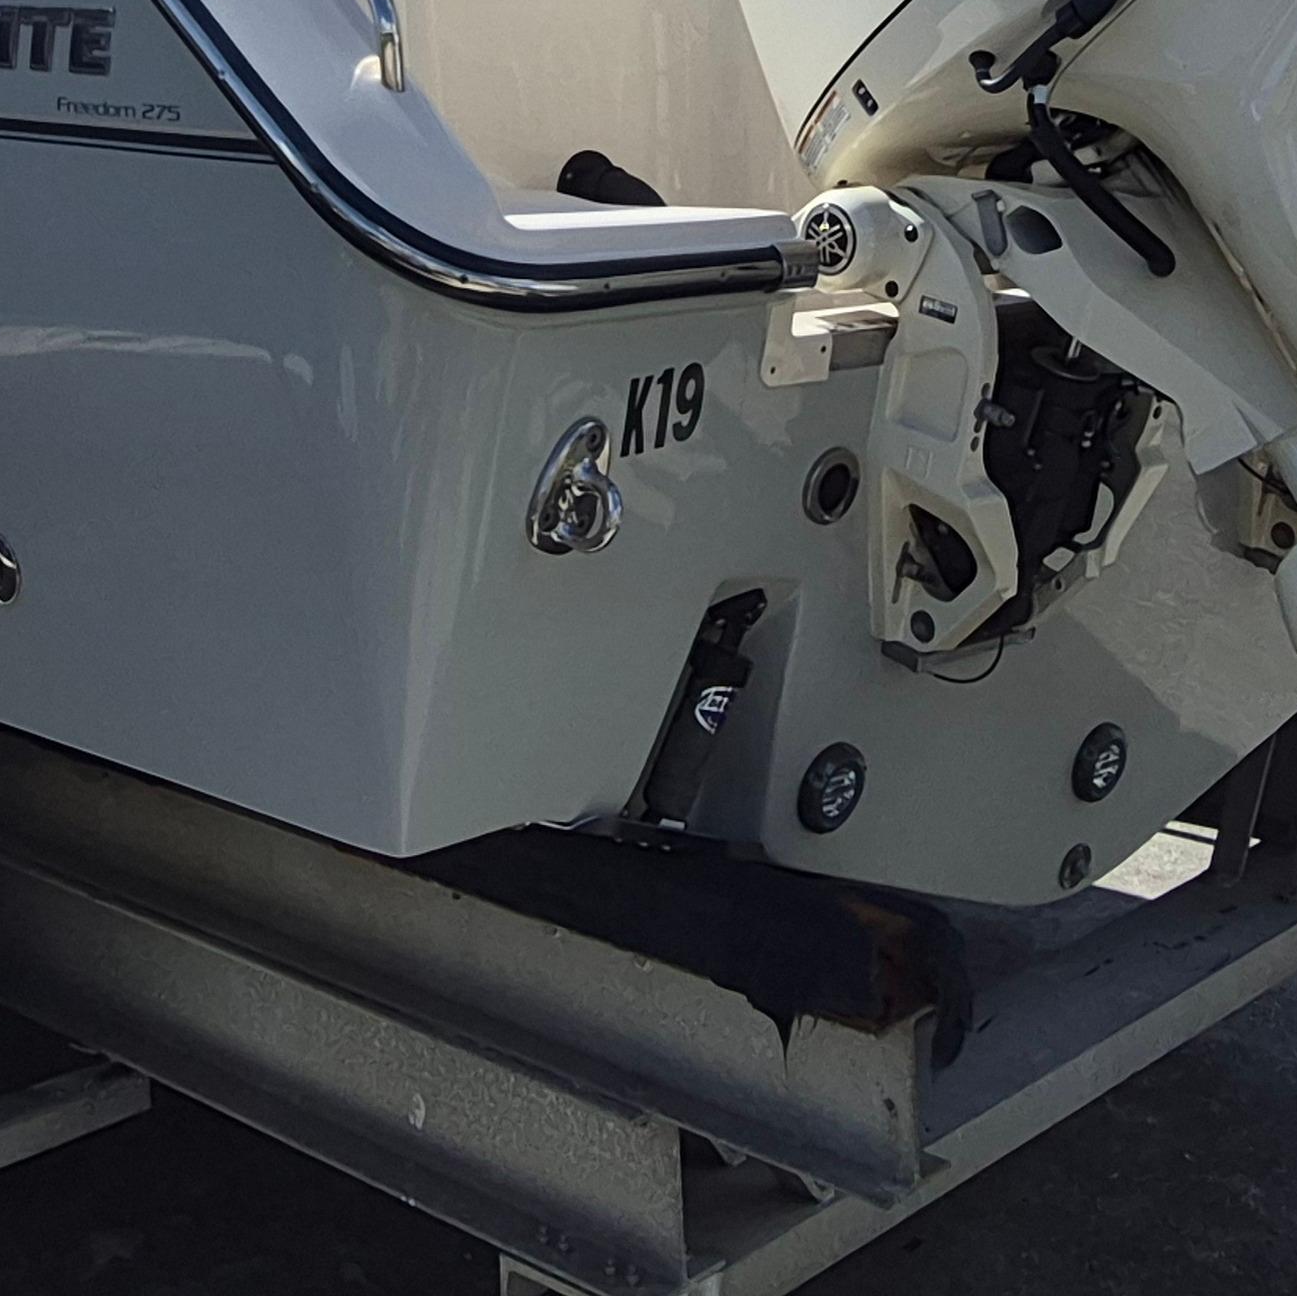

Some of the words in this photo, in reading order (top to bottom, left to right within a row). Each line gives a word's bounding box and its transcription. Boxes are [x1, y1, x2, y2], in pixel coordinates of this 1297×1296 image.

[56, 96, 136, 118] Freedom
[142, 103, 181, 121] 275
[620, 362, 705, 457] K19
